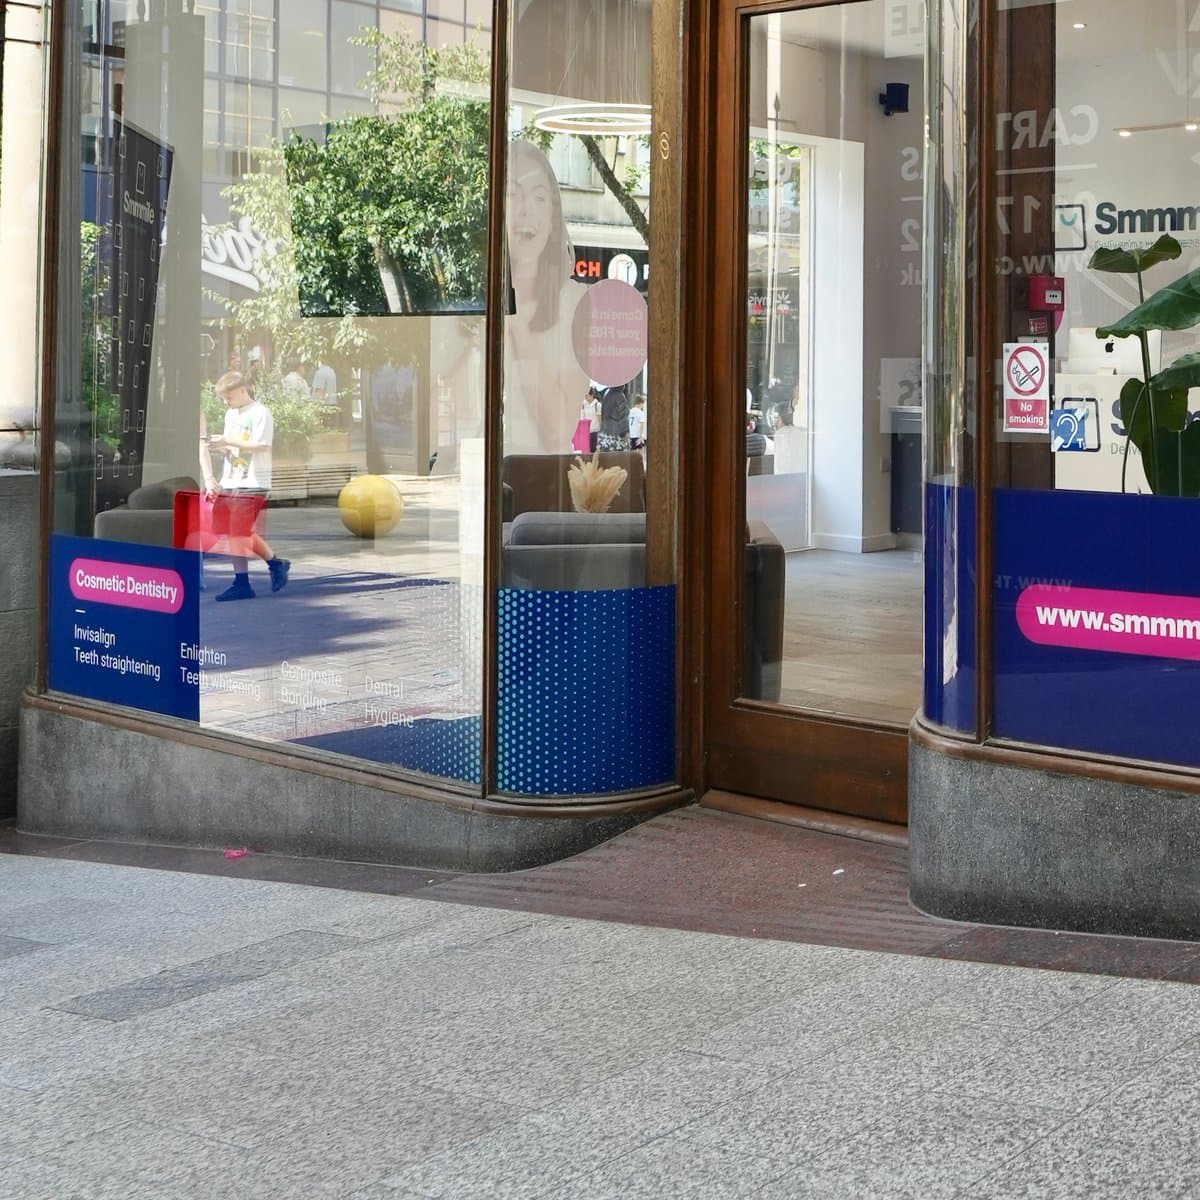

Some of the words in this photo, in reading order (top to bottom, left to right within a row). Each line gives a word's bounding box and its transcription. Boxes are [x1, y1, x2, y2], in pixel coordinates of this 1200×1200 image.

[1009, 413, 1044, 427] smoking
[1019, 402, 1033, 413] No
[76, 569, 126, 593] Cosmetic
[127, 576, 177, 604] Dentistry
[74, 623, 116, 648] Invisalign
[74, 646, 99, 666] Teeth
[101, 654, 161, 681] straightening
[180, 642, 227, 666] Enlighten
[180, 666, 208, 687] Teeth
[211, 672, 261, 702] whitening
[281, 660, 343, 688] Composite
[364, 675, 404, 699] Dental
[280, 686, 327, 714] Bonding
[364, 703, 414, 730] Hygiene
